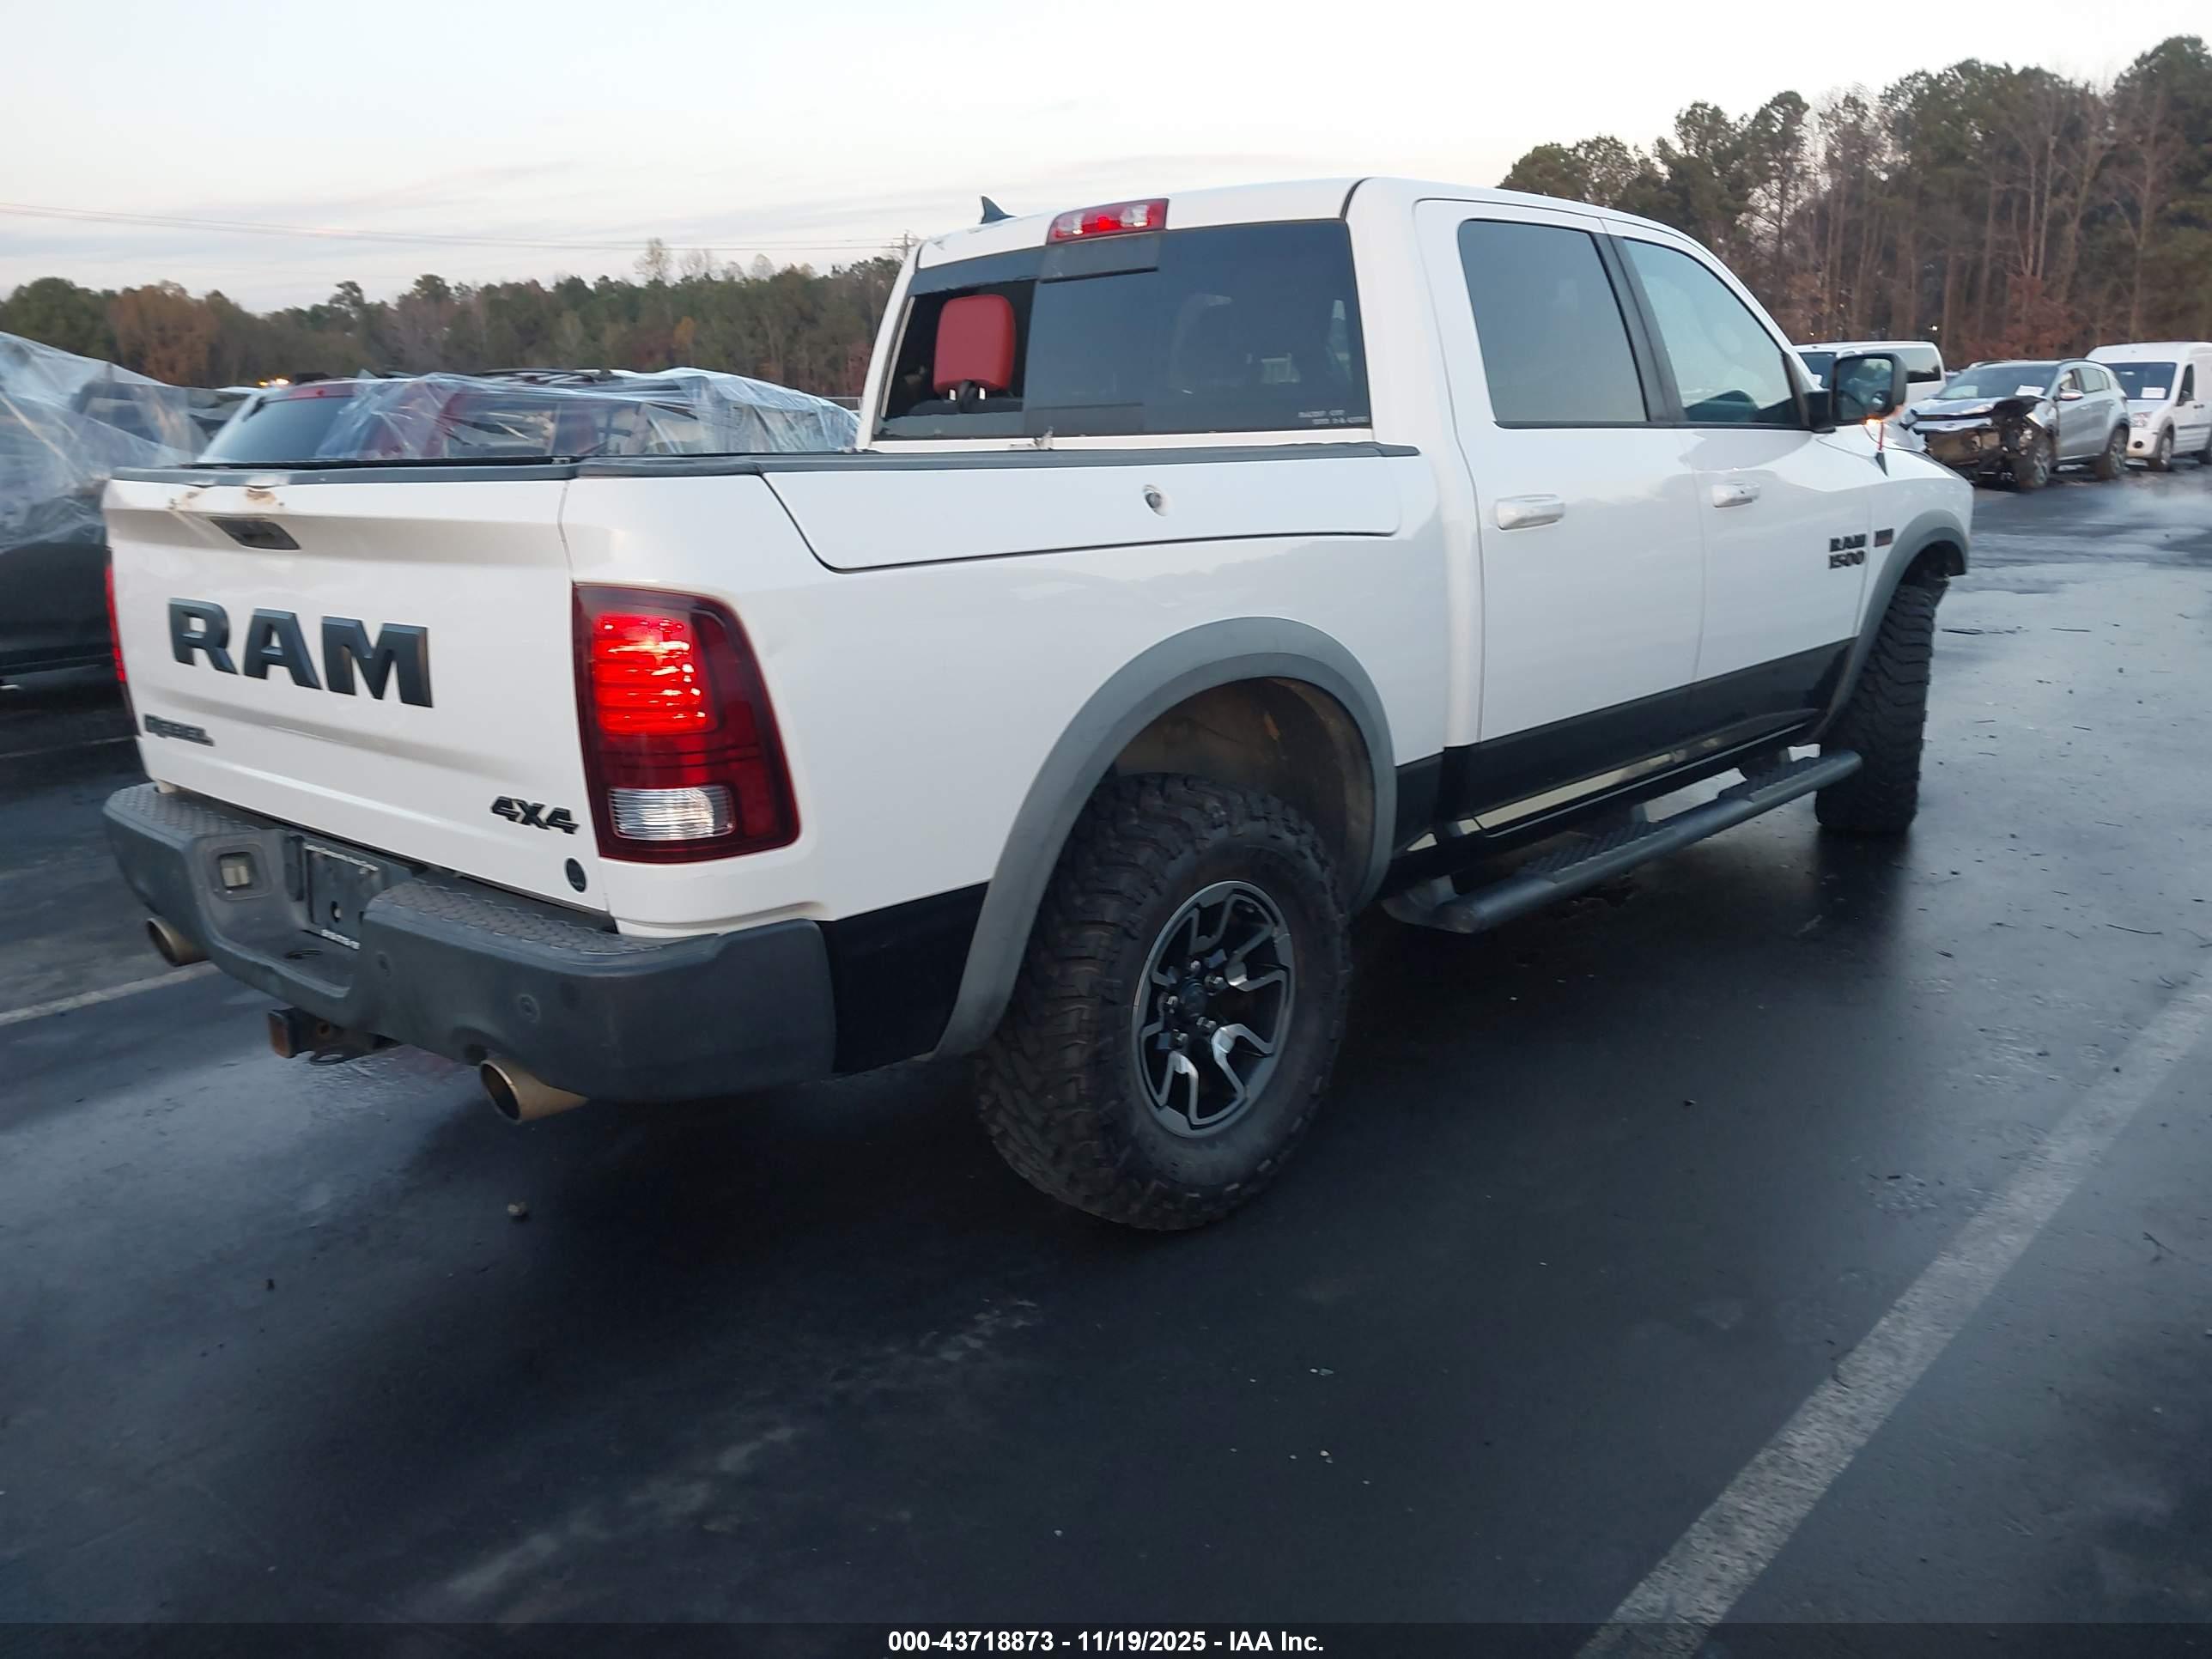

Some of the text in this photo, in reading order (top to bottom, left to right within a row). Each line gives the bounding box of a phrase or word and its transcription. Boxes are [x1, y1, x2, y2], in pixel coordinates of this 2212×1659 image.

[1829, 533, 1866, 552] RAM
[1829, 550, 1864, 568] 1500
[168, 598, 434, 708] RAM
